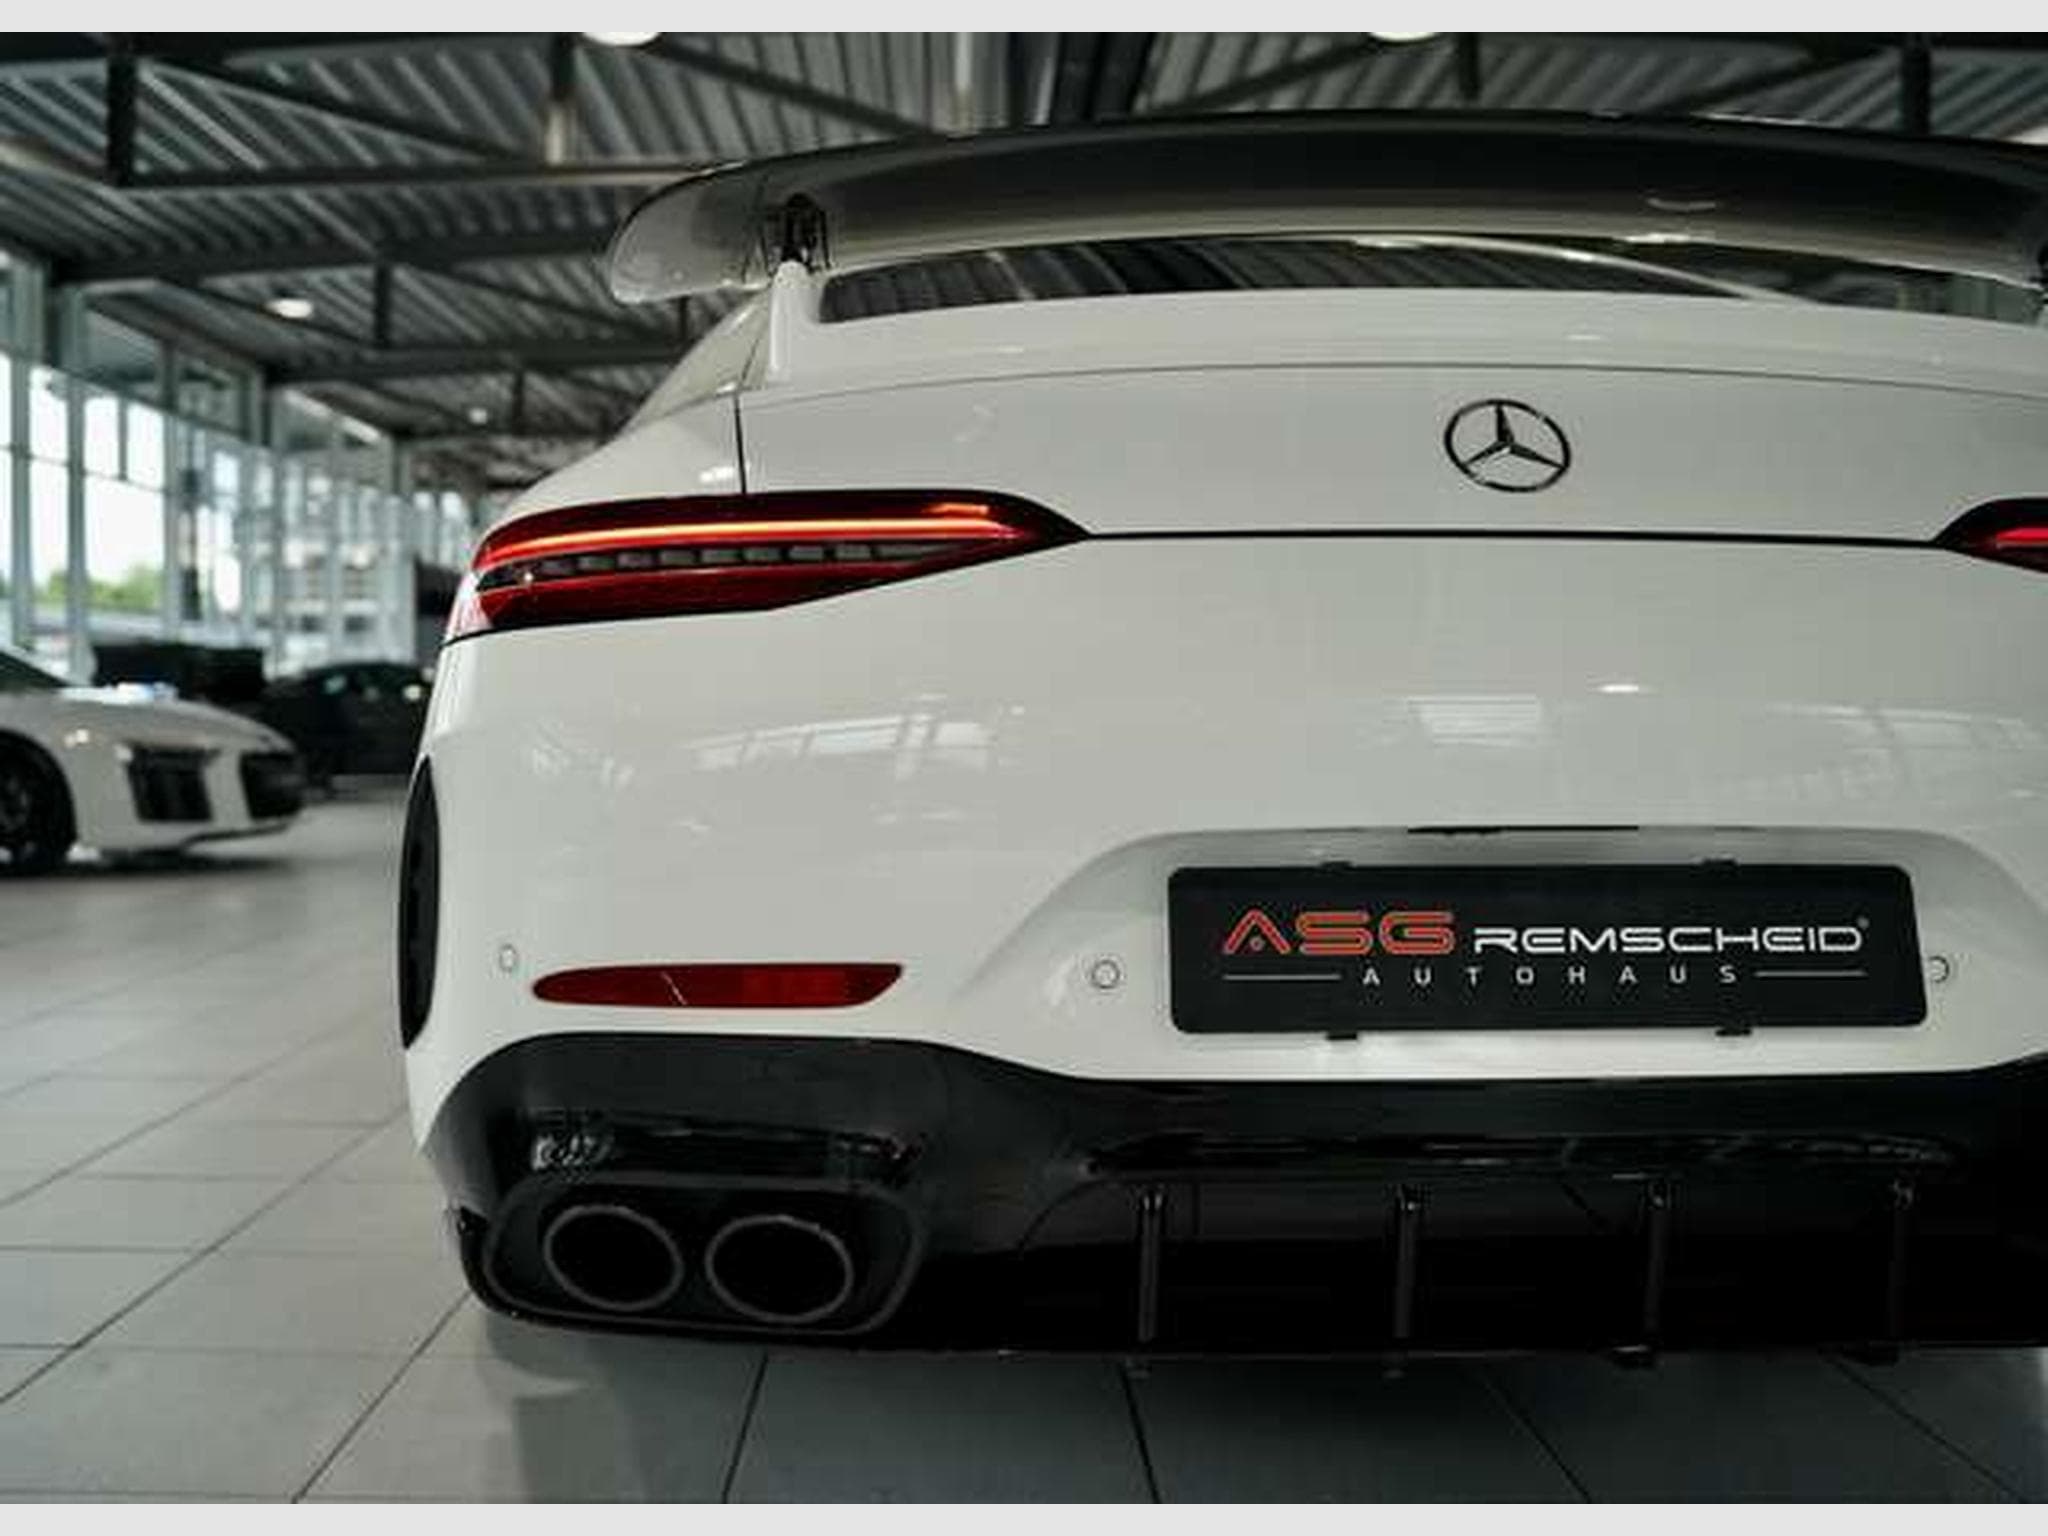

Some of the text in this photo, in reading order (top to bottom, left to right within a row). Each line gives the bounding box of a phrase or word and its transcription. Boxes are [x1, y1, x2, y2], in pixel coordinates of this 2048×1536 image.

[1222, 910, 1863, 955] ASG REMSCHEID
[1362, 964, 1738, 985] AUTOHAUS
